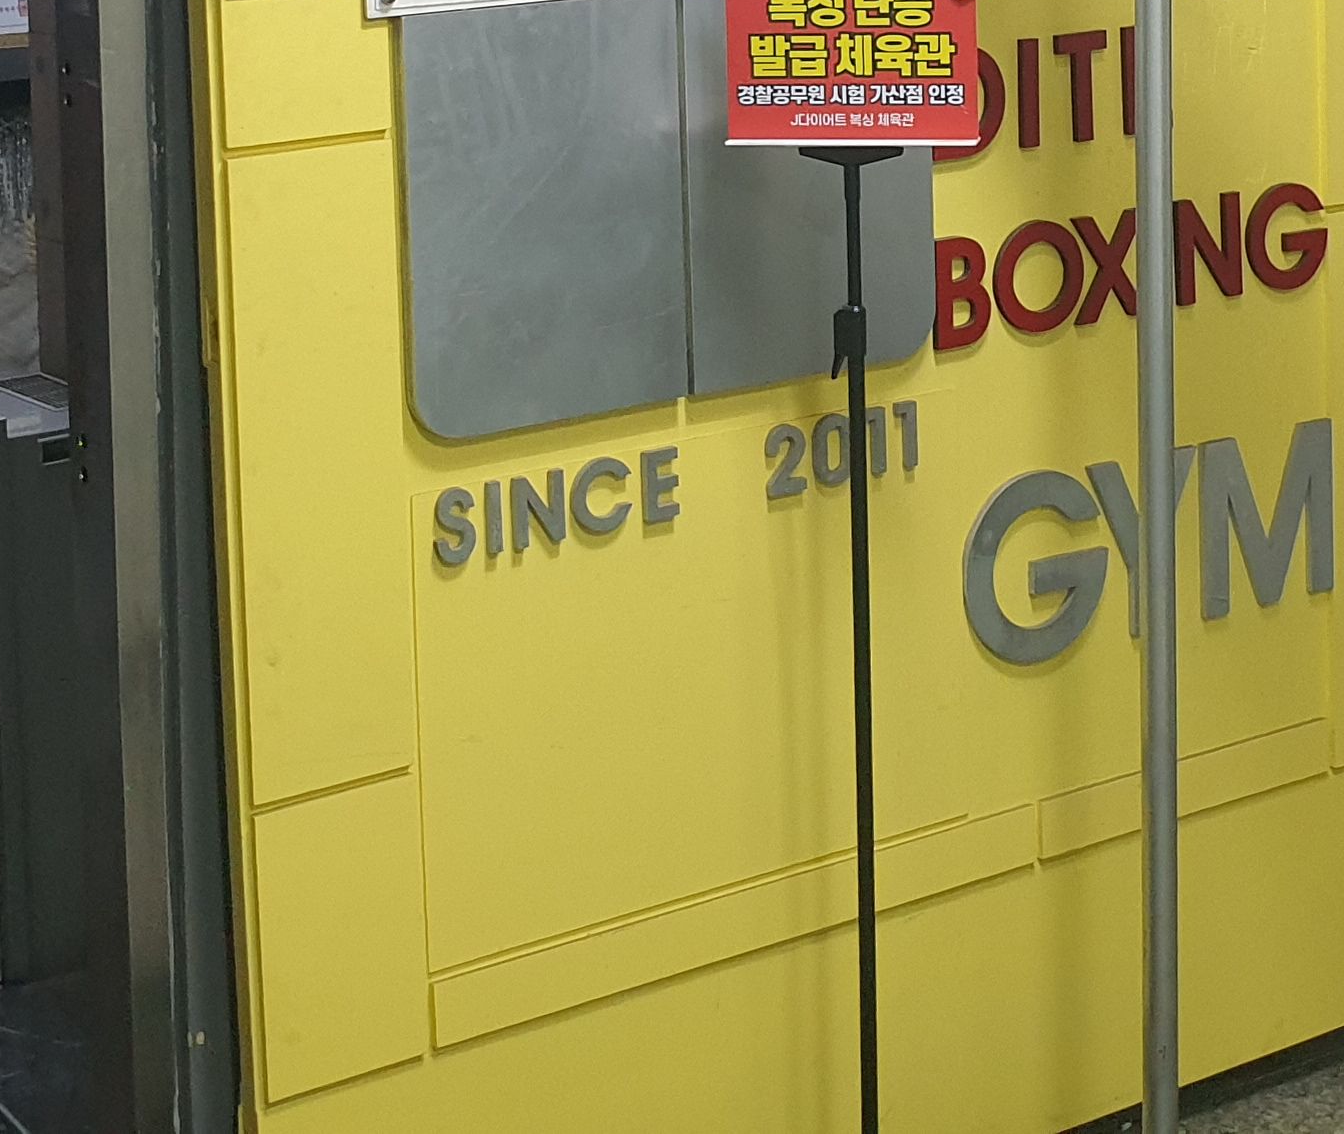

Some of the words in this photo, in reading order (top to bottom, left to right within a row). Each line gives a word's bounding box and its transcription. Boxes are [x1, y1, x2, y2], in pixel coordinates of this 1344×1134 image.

[737, 85, 824, 105] 경찰공무원
[830, 85, 865, 105] 시험
[870, 85, 923, 105] 가산점
[928, 85, 964, 105] 인정
[749, 34, 828, 78] 발급
[835, 33, 956, 78] 체육관
[790, 113, 847, 126] J다이어트
[850, 113, 874, 126] 복싱
[878, 113, 915, 126] 체육관
[933, 184, 1328, 350] BOXNG
[434, 445, 680, 566] SINCE
[765, 401, 918, 500] 2011
[963, 417, 1333, 665] GYM
